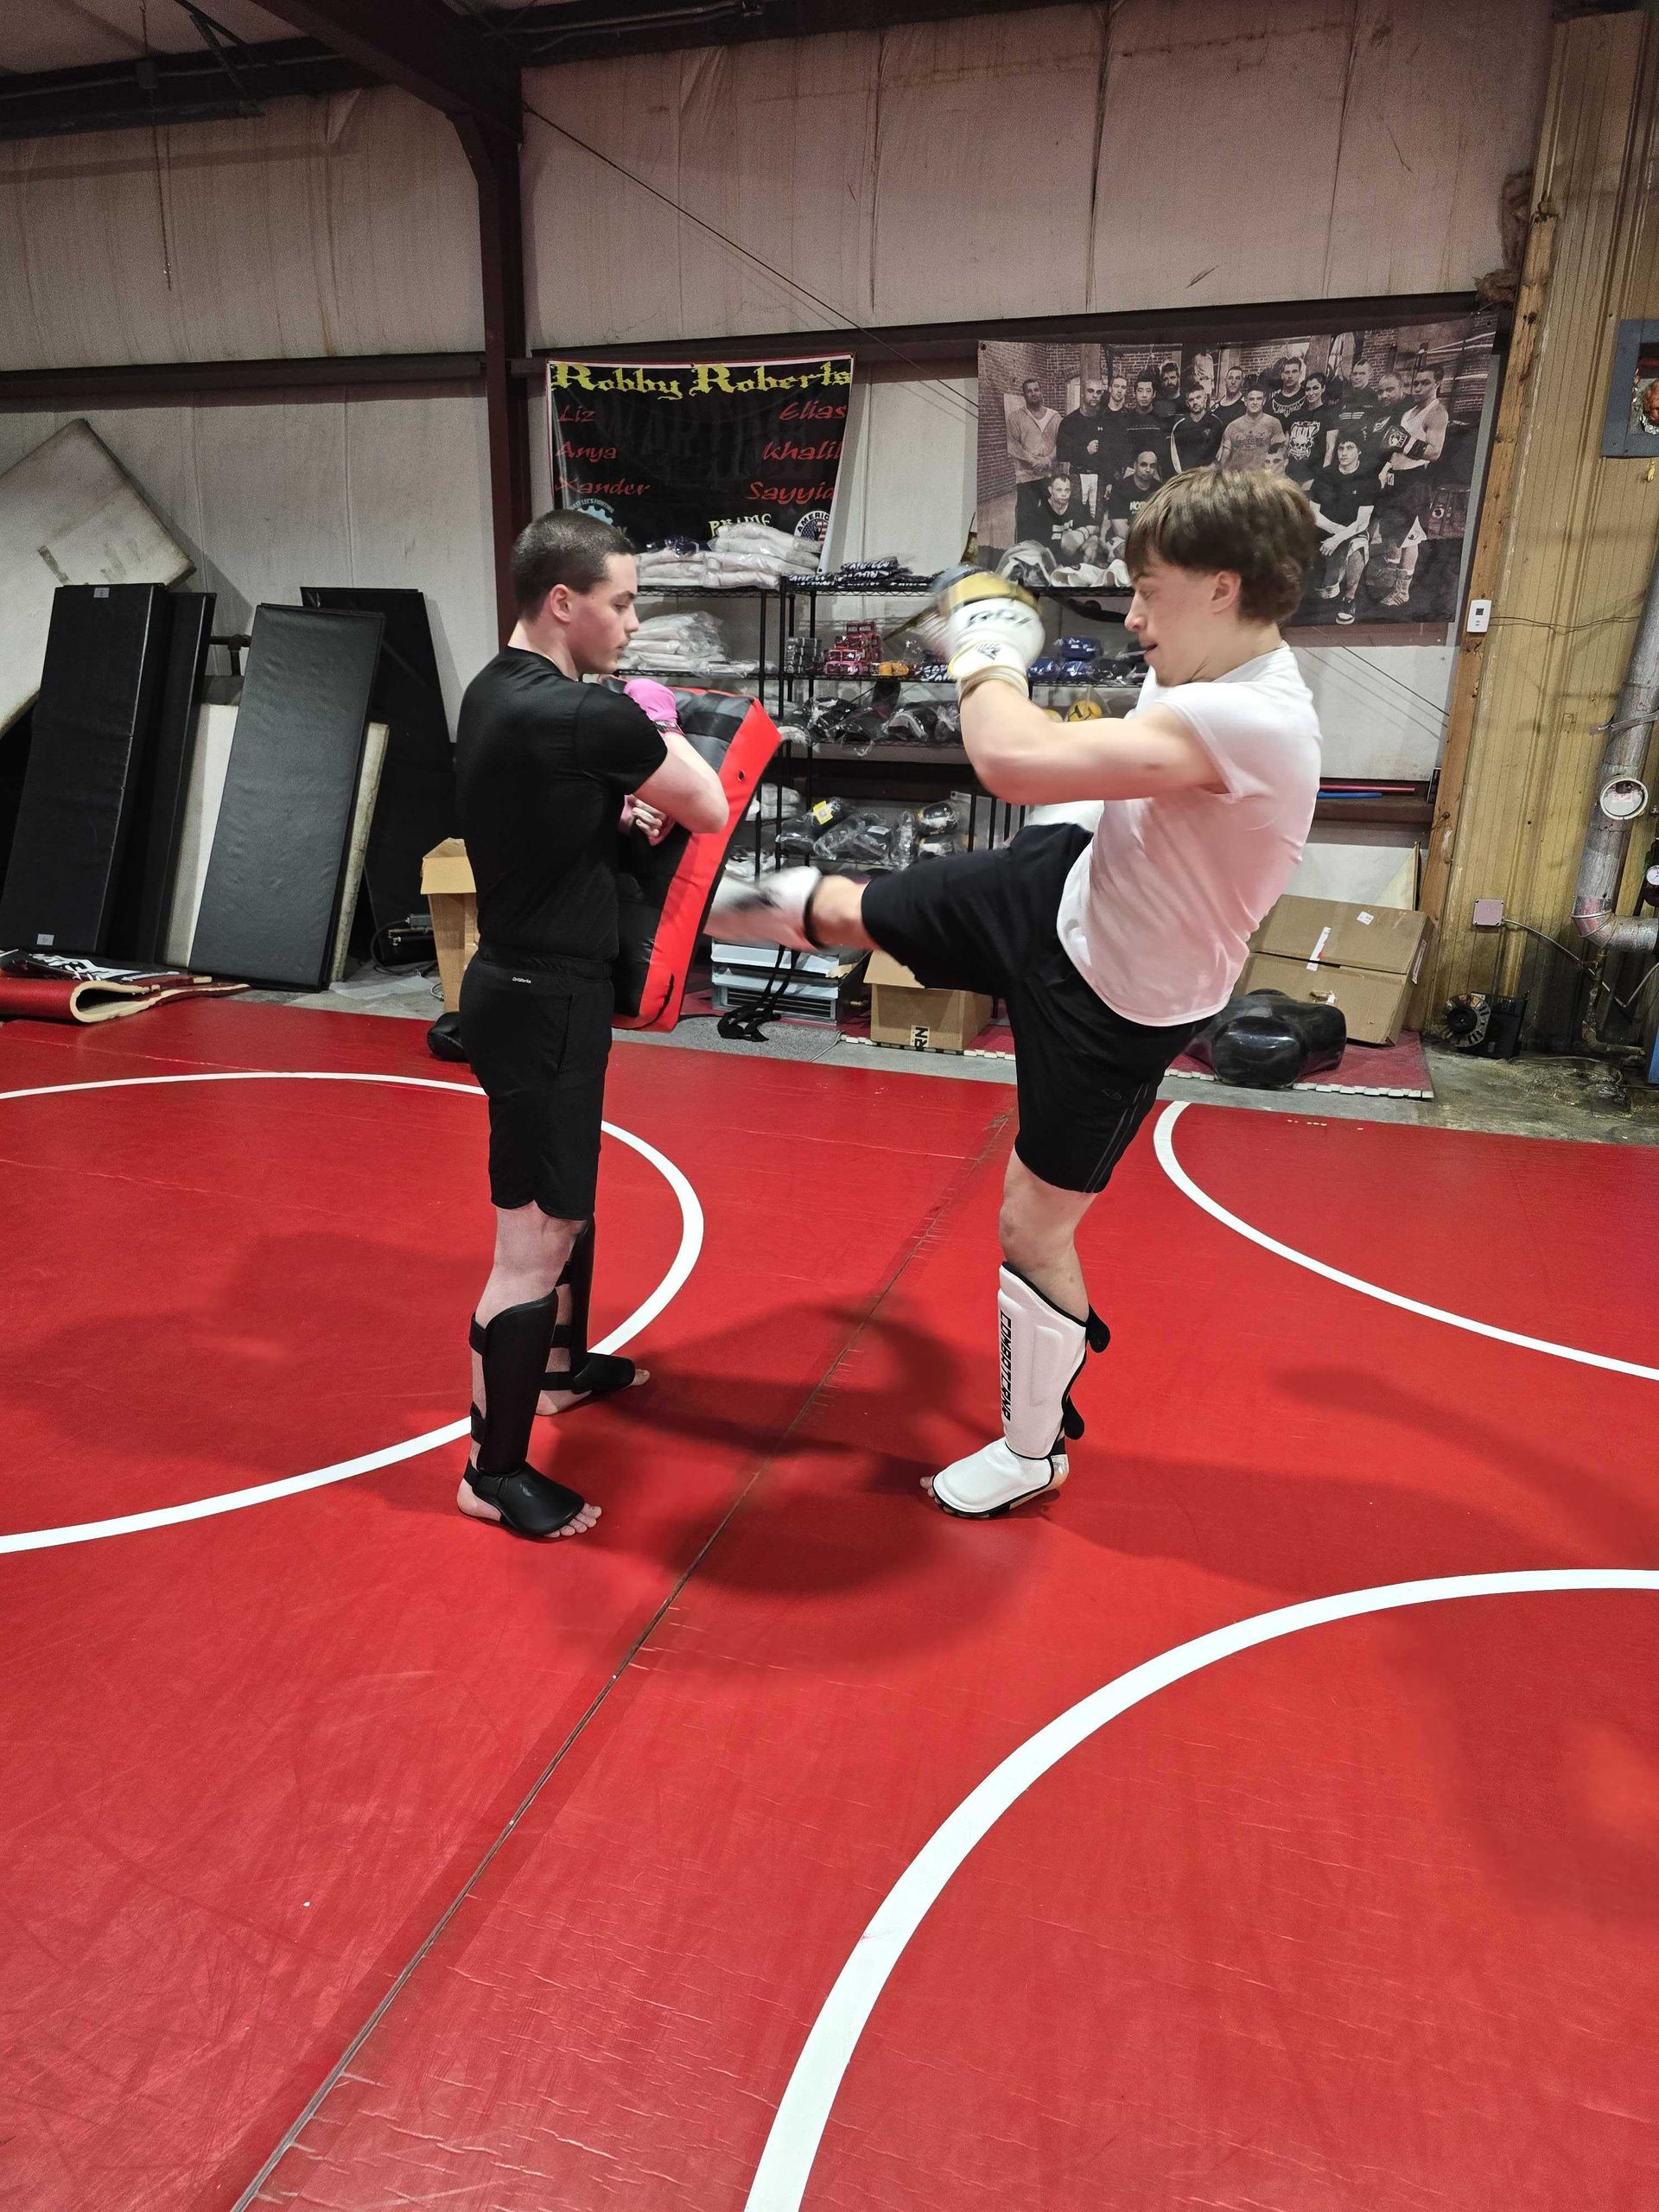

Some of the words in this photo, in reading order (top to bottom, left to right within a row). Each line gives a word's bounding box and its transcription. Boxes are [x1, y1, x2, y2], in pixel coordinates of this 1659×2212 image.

[551, 363, 683, 400] Robby
[689, 361, 851, 397] Roberts
[559, 404, 595, 422] Liz
[779, 401, 847, 421] Elias
[556, 441, 617, 463] Anya
[555, 477, 651, 495] Xander
